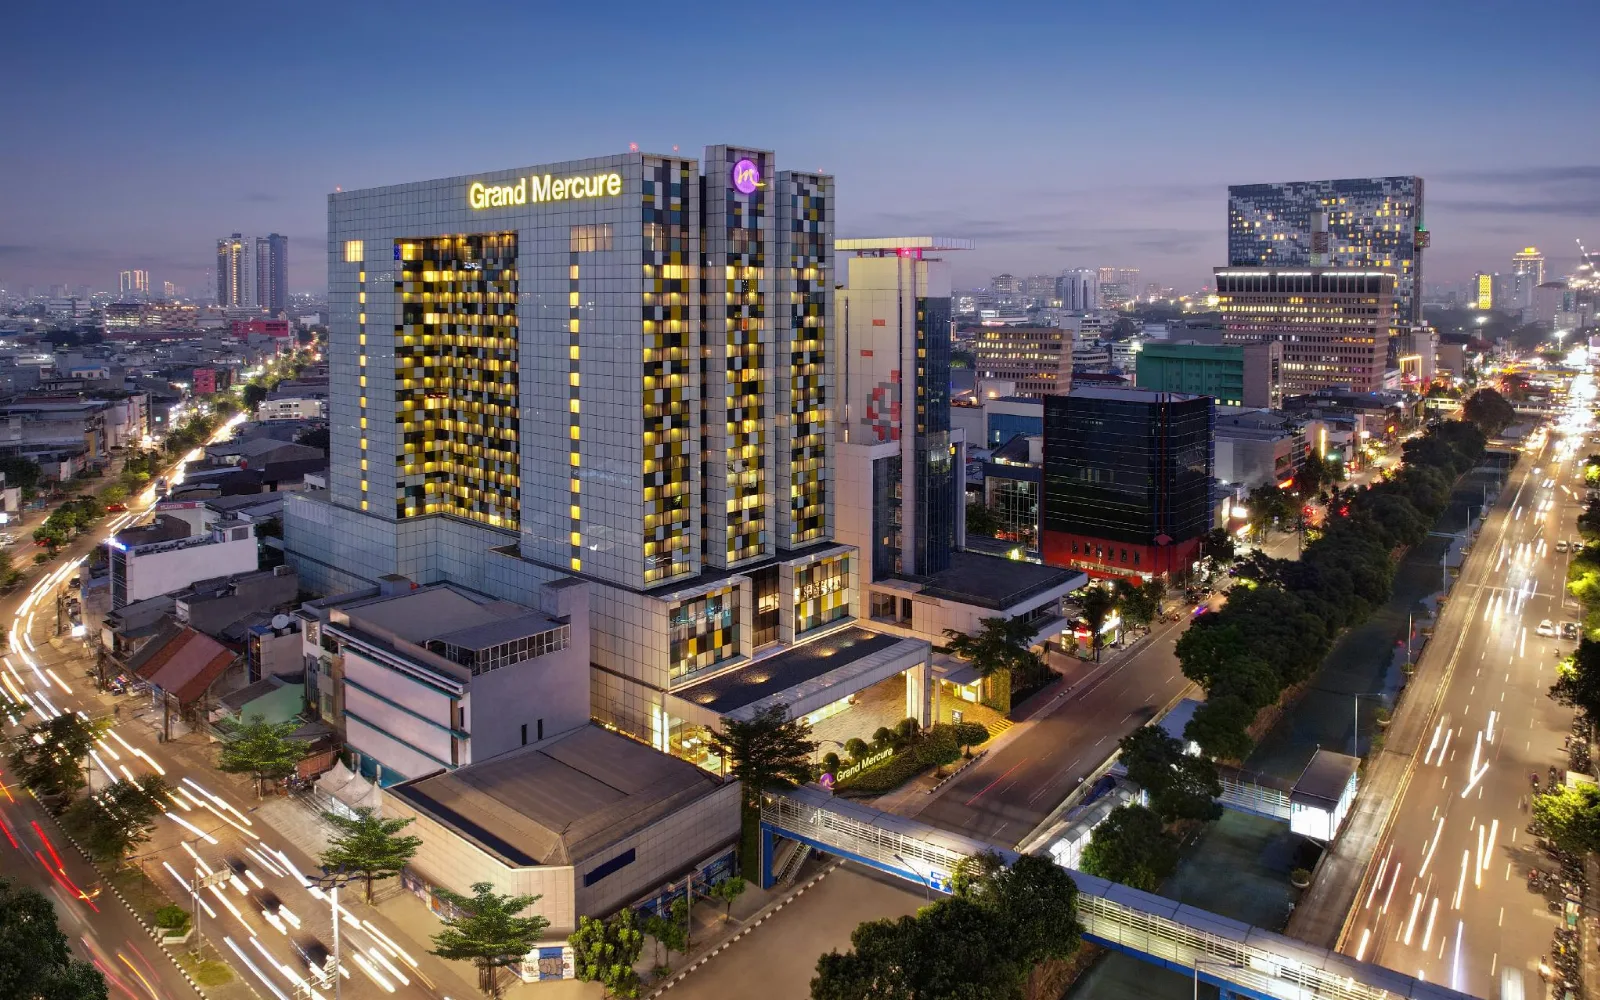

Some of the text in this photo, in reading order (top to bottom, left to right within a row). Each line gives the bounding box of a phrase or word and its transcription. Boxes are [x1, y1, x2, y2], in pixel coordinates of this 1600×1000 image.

[469, 173, 621, 209] Grand Mercure
[836, 747, 893, 782] Grand Mercure
